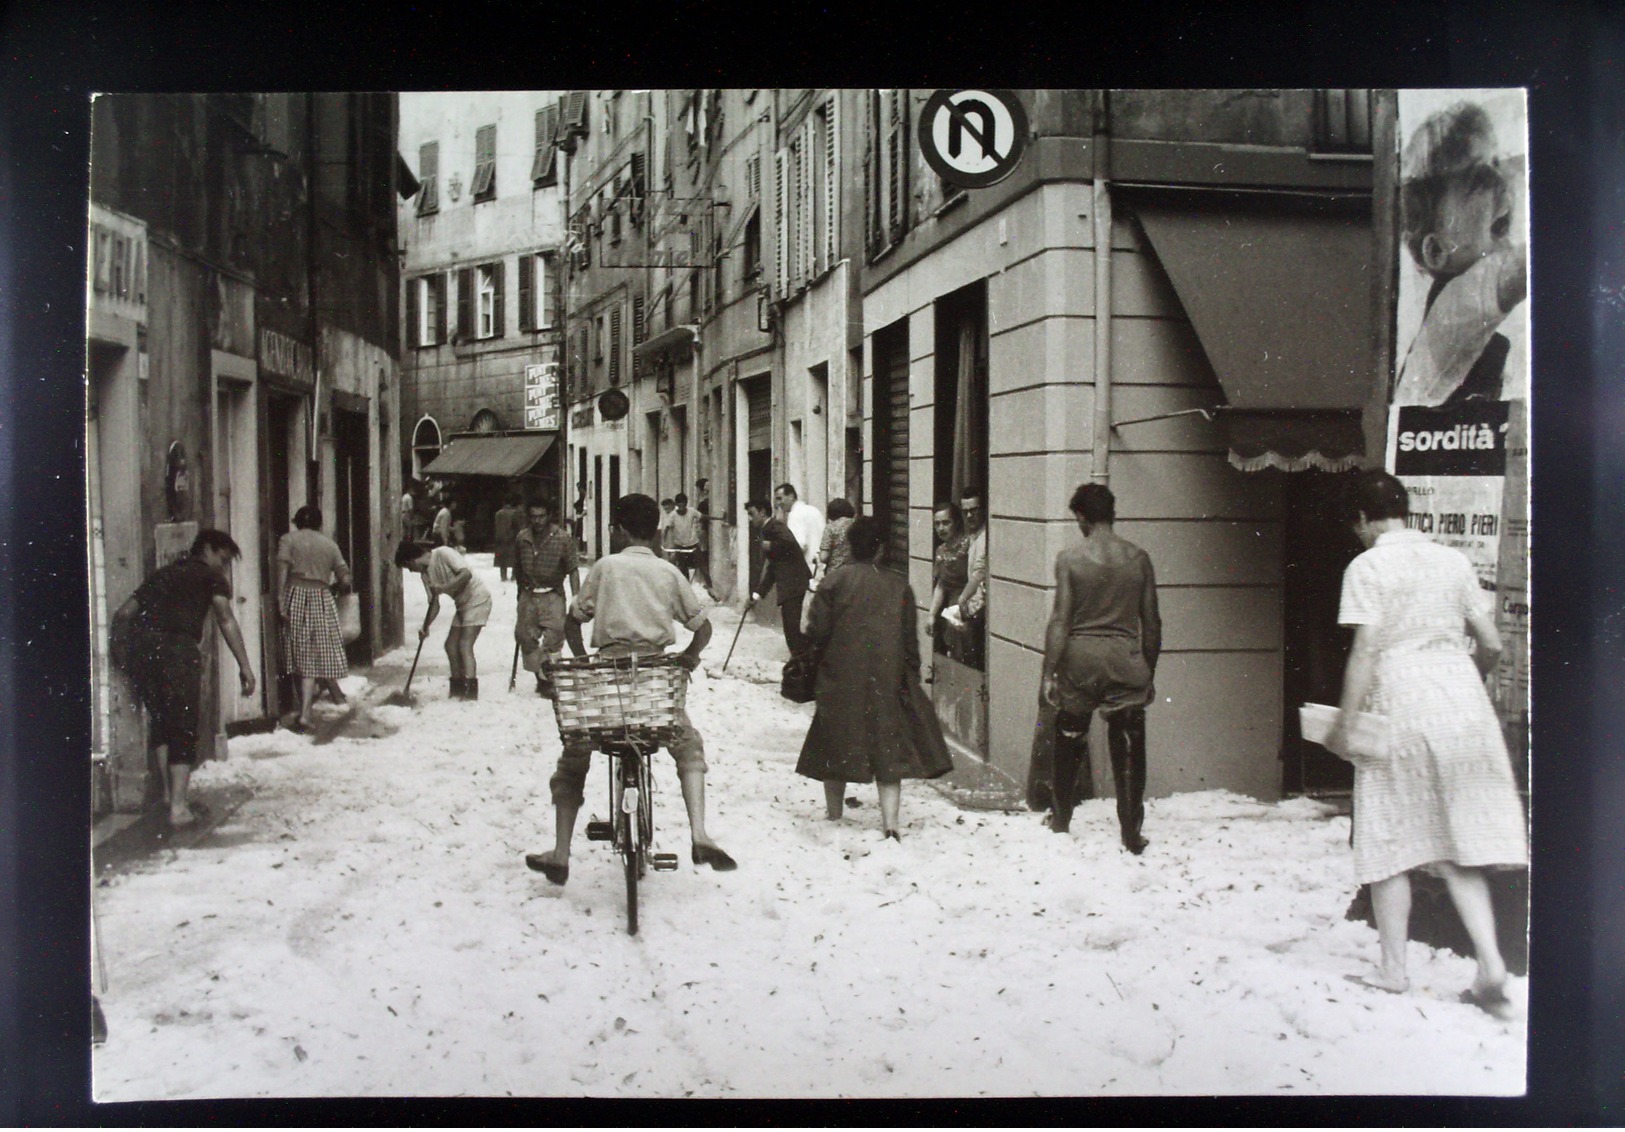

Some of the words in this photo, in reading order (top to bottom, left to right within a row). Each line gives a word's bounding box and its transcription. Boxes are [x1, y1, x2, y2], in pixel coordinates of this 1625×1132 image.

[1399, 422, 1495, 452] sordità
[1438, 512, 1466, 535] PIERO
[1471, 513, 1498, 536] PIERI
